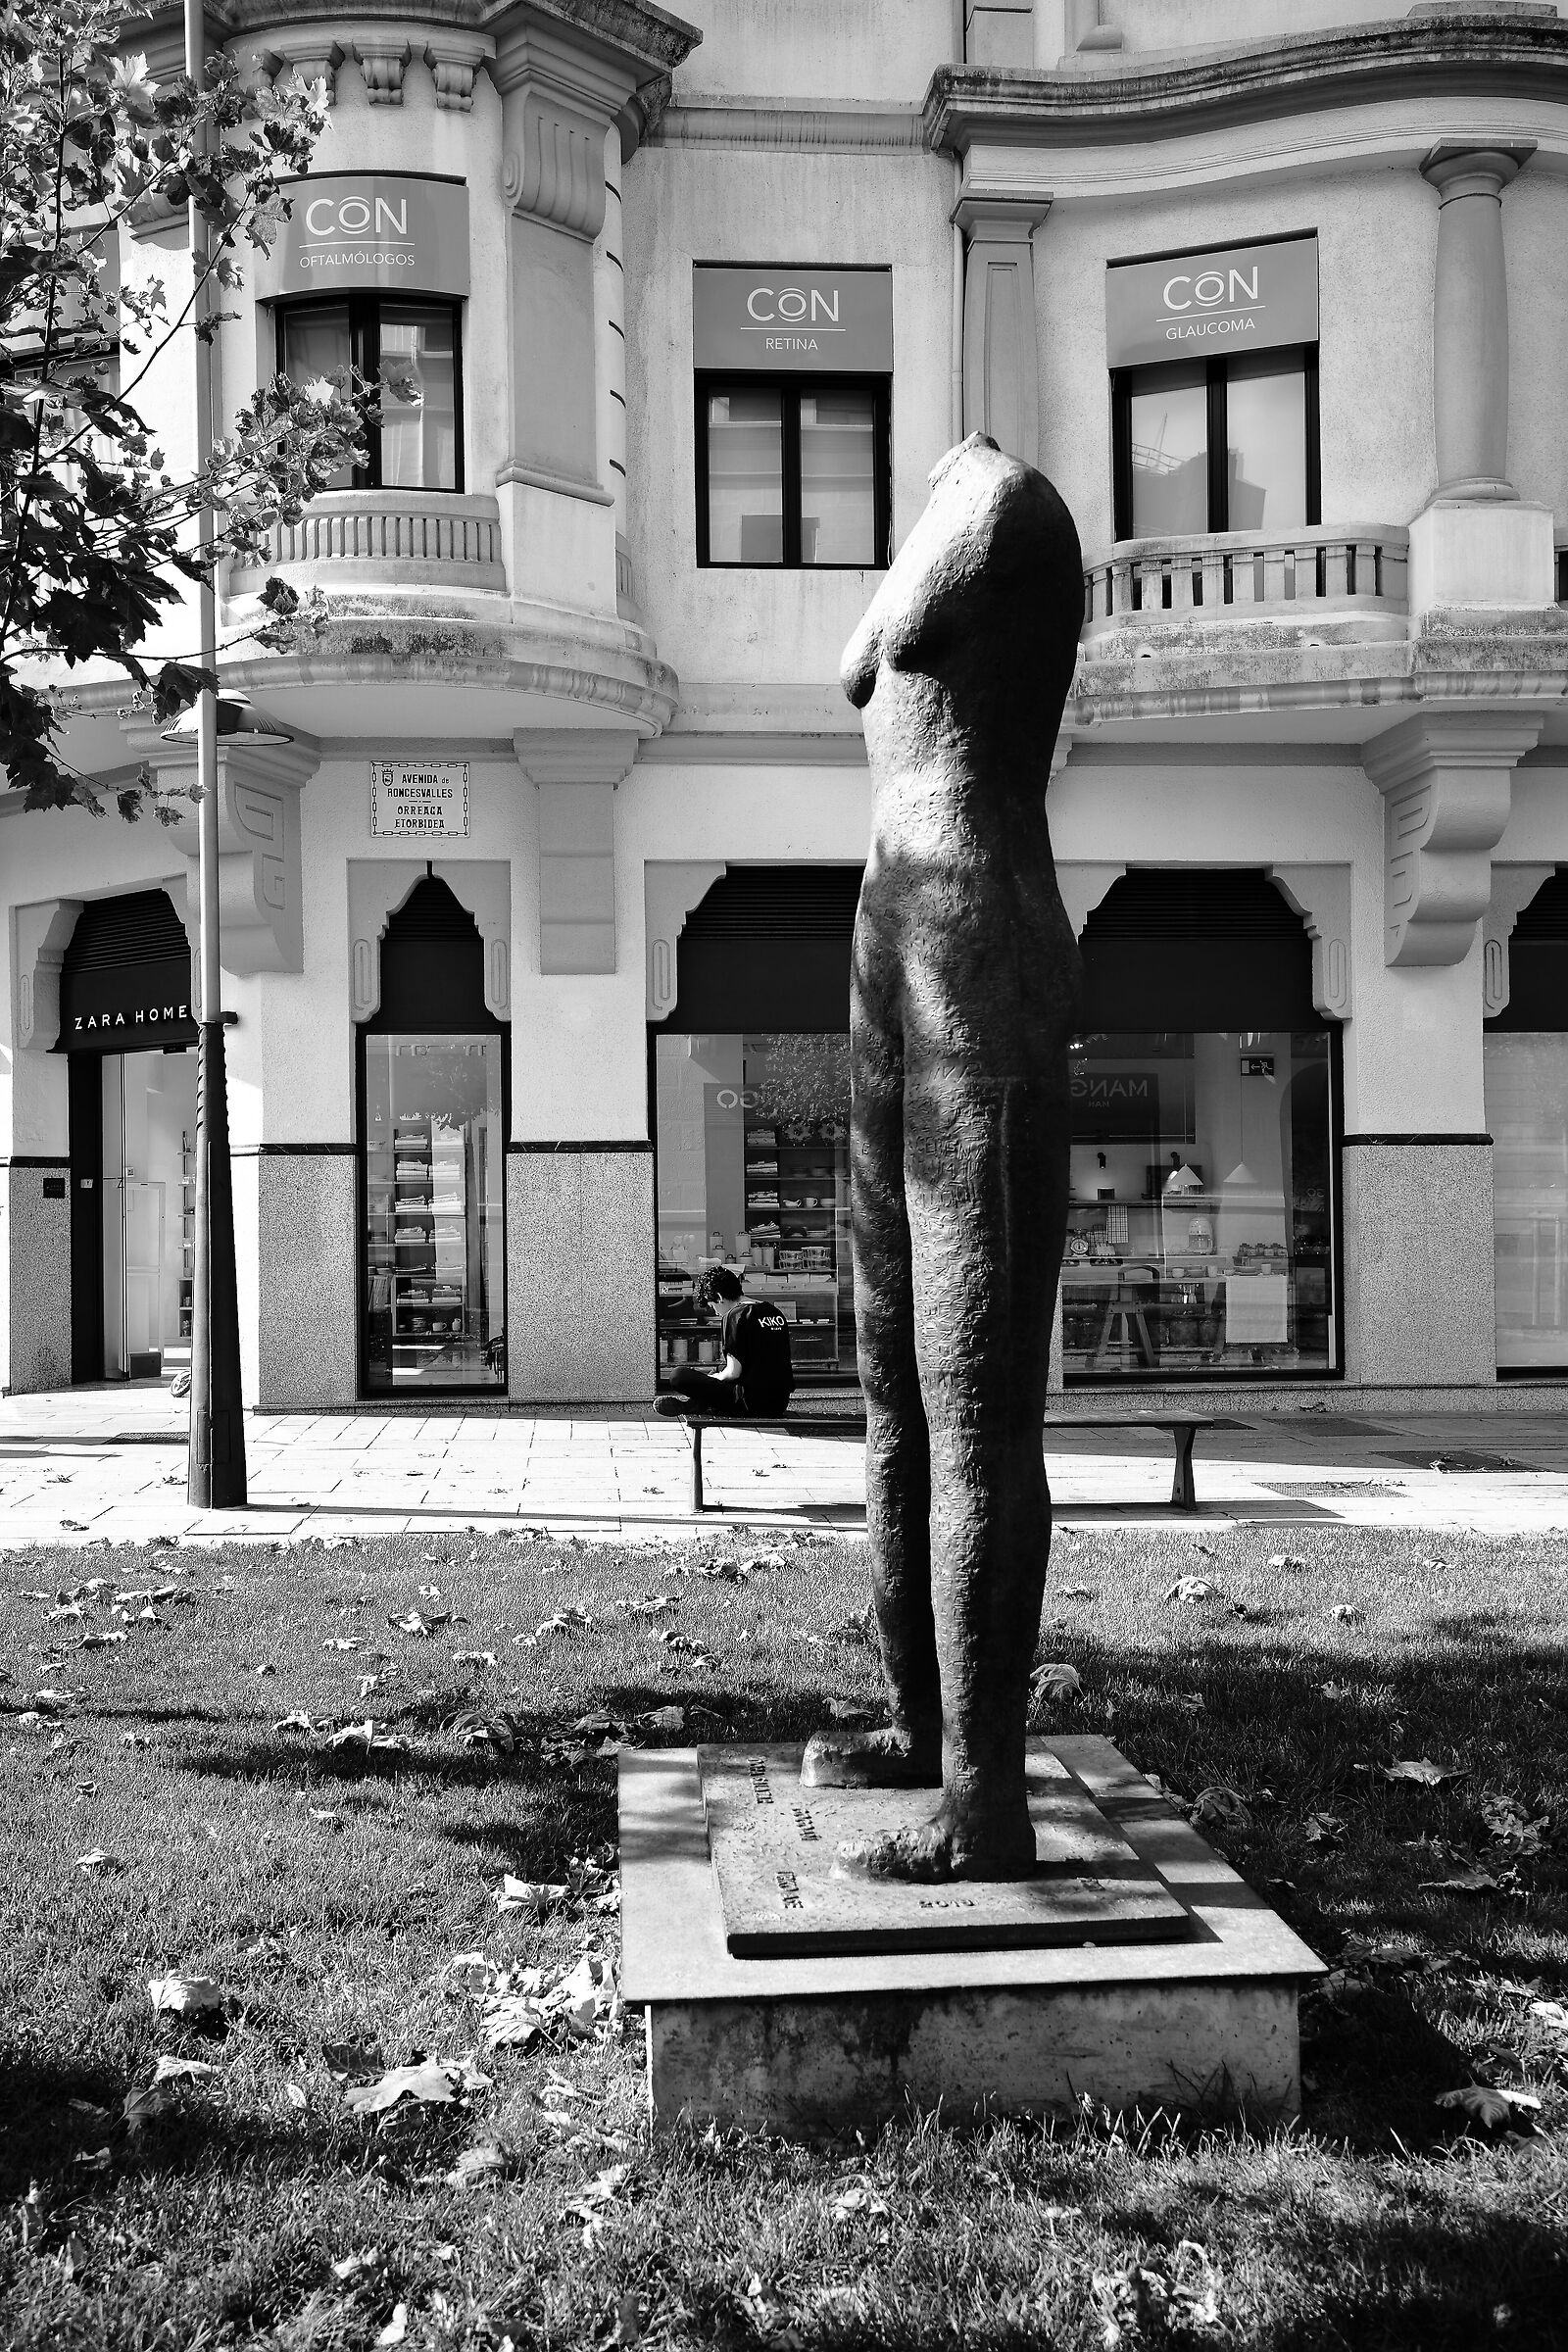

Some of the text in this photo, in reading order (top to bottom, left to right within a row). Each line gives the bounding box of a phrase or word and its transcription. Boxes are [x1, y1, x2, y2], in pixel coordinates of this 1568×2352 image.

[306, 196, 408, 236] CON
[299, 250, 416, 269] OFTALMÓLOGOS
[1162, 266, 1258, 311] CON
[747, 287, 839, 322] CON
[1165, 318, 1255, 340] GLAUCOMA
[764, 337, 818, 351] RETINA
[401, 773, 438, 784] AVENIDA
[387, 787, 453, 799] RONCESVALLES
[397, 806, 443, 815] ORREAGA
[394, 818, 445, 829] ETORBIDEA
[74, 1004, 187, 1030] ZARA HOME
[758, 1315, 784, 1328] KIKO
